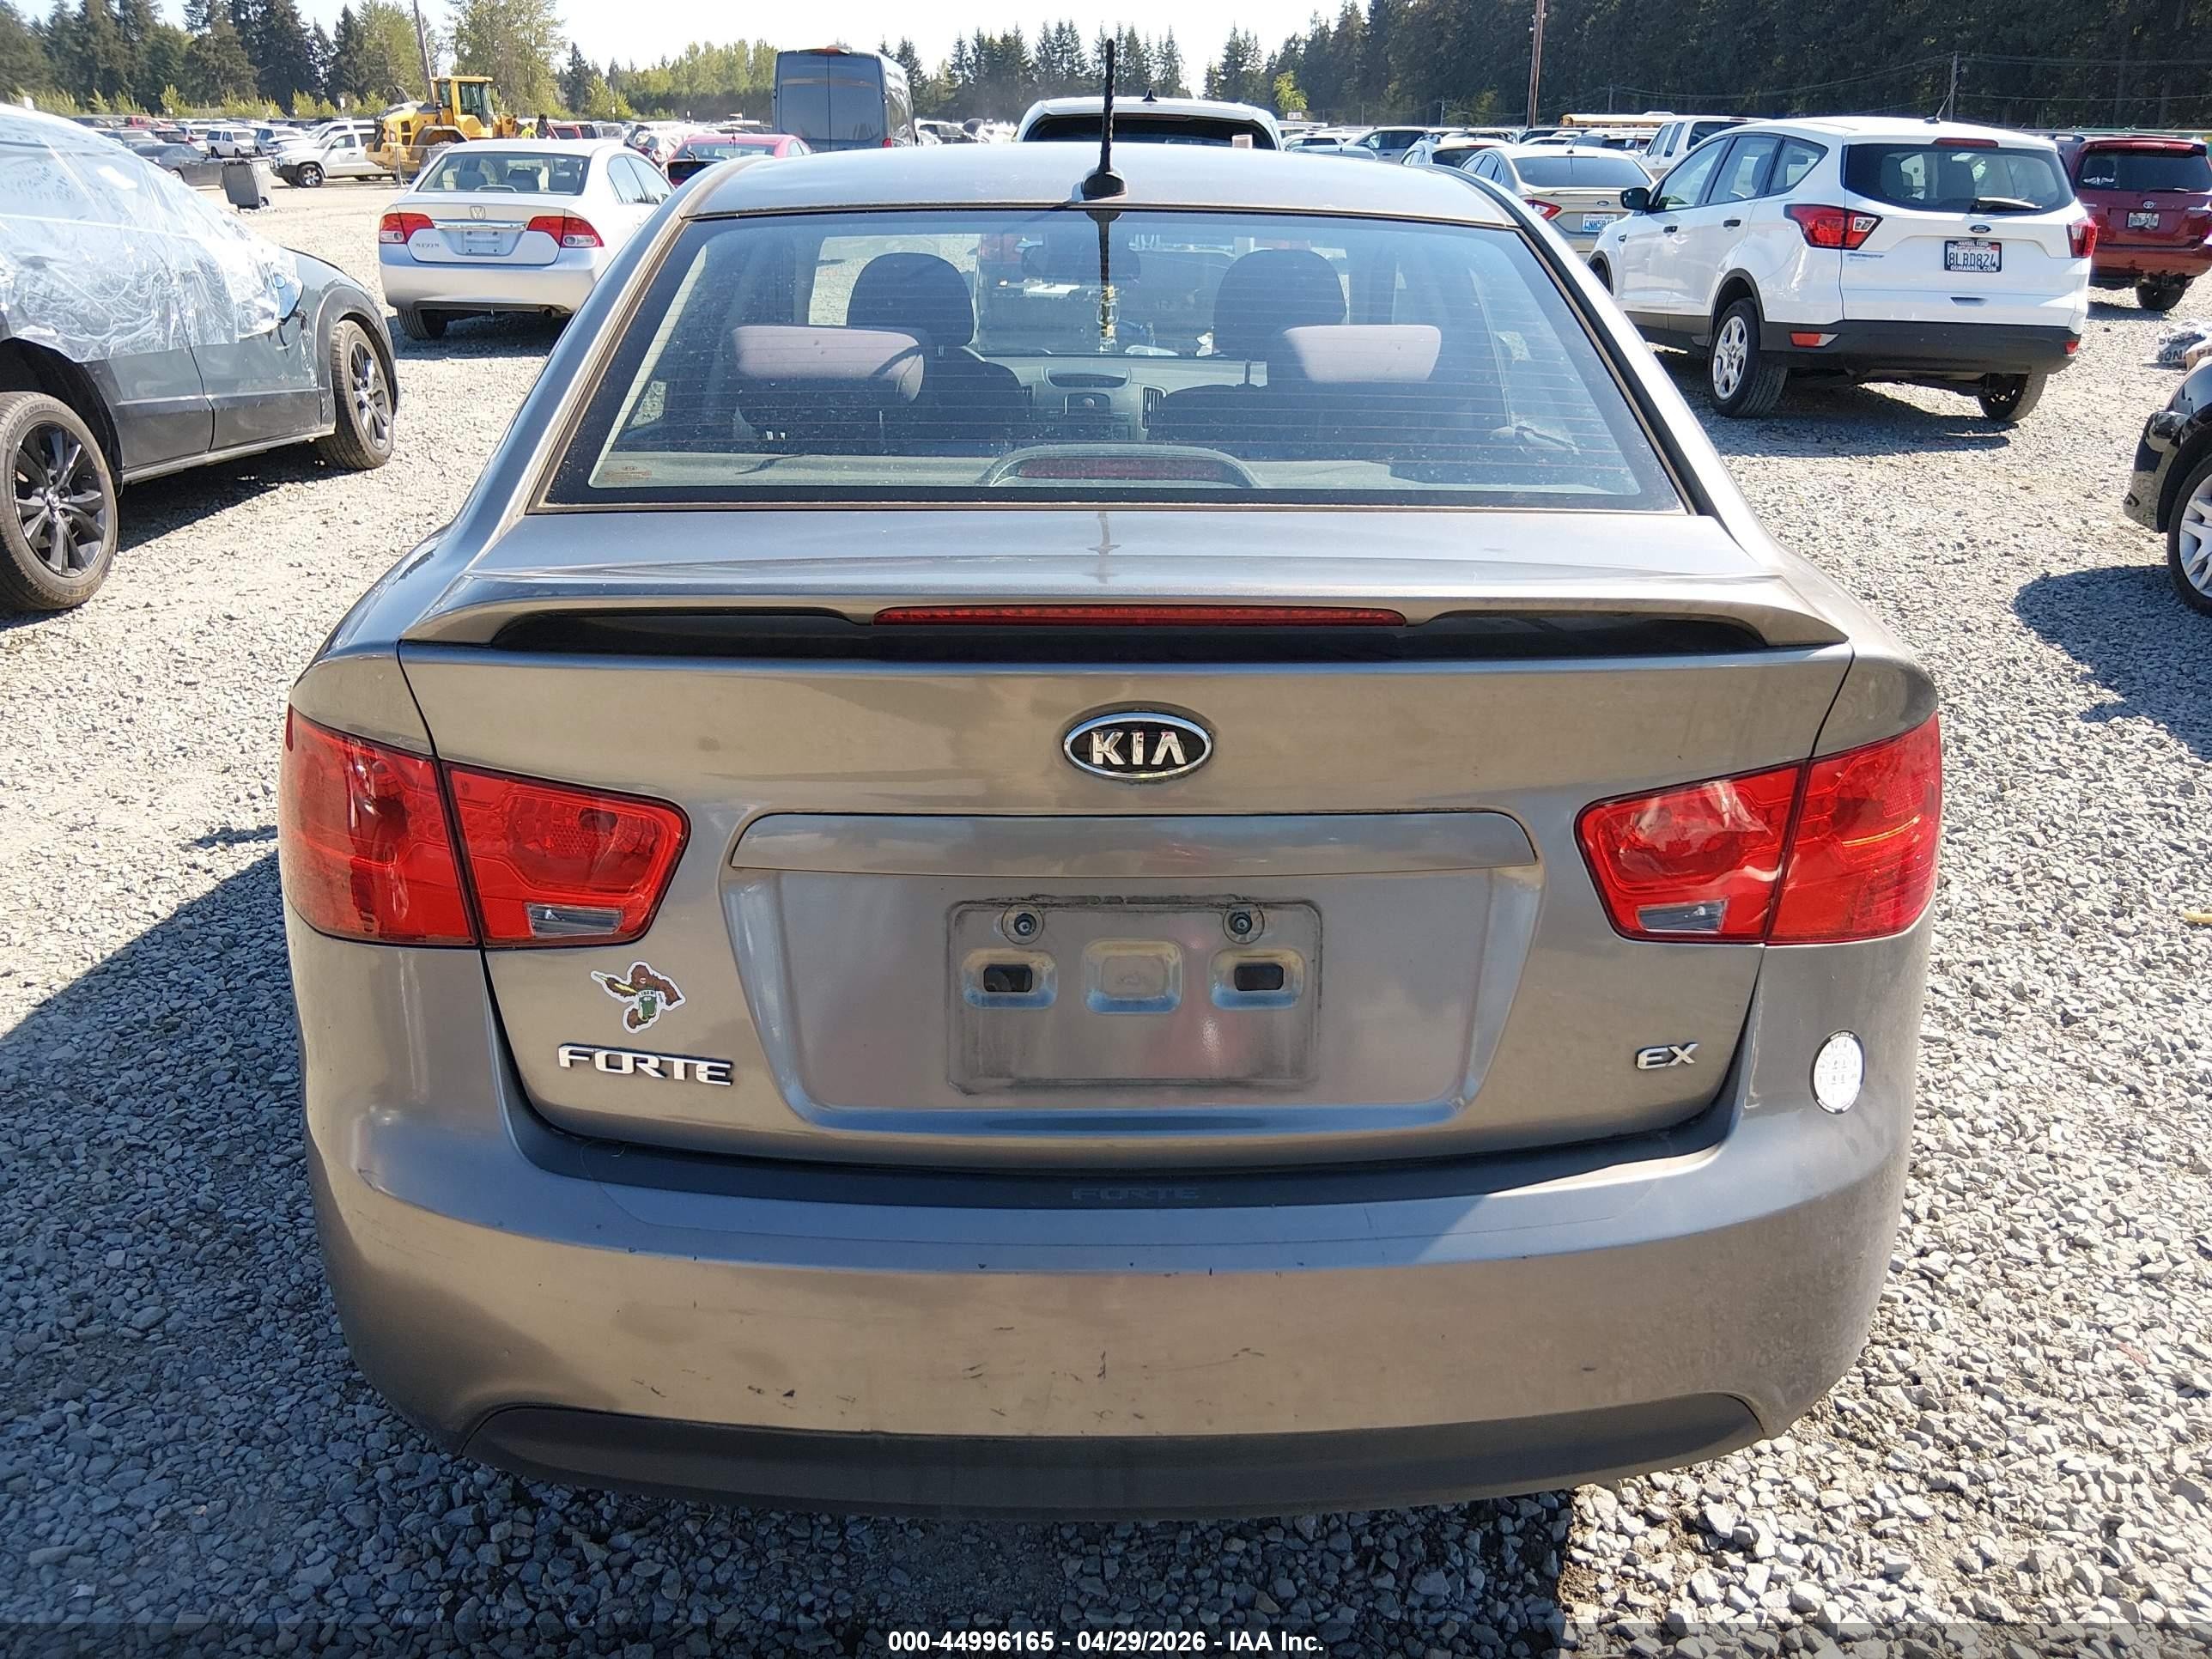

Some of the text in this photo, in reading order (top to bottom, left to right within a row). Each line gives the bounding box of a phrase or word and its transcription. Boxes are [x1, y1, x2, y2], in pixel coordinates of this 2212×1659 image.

[1948, 252, 1996, 267] 8LBD824
[1091, 731, 1188, 765] KIA
[557, 1042, 733, 1086] FORTE
[1635, 1042, 1698, 1070] EX
[1073, 1188, 1199, 1200] FORTE
